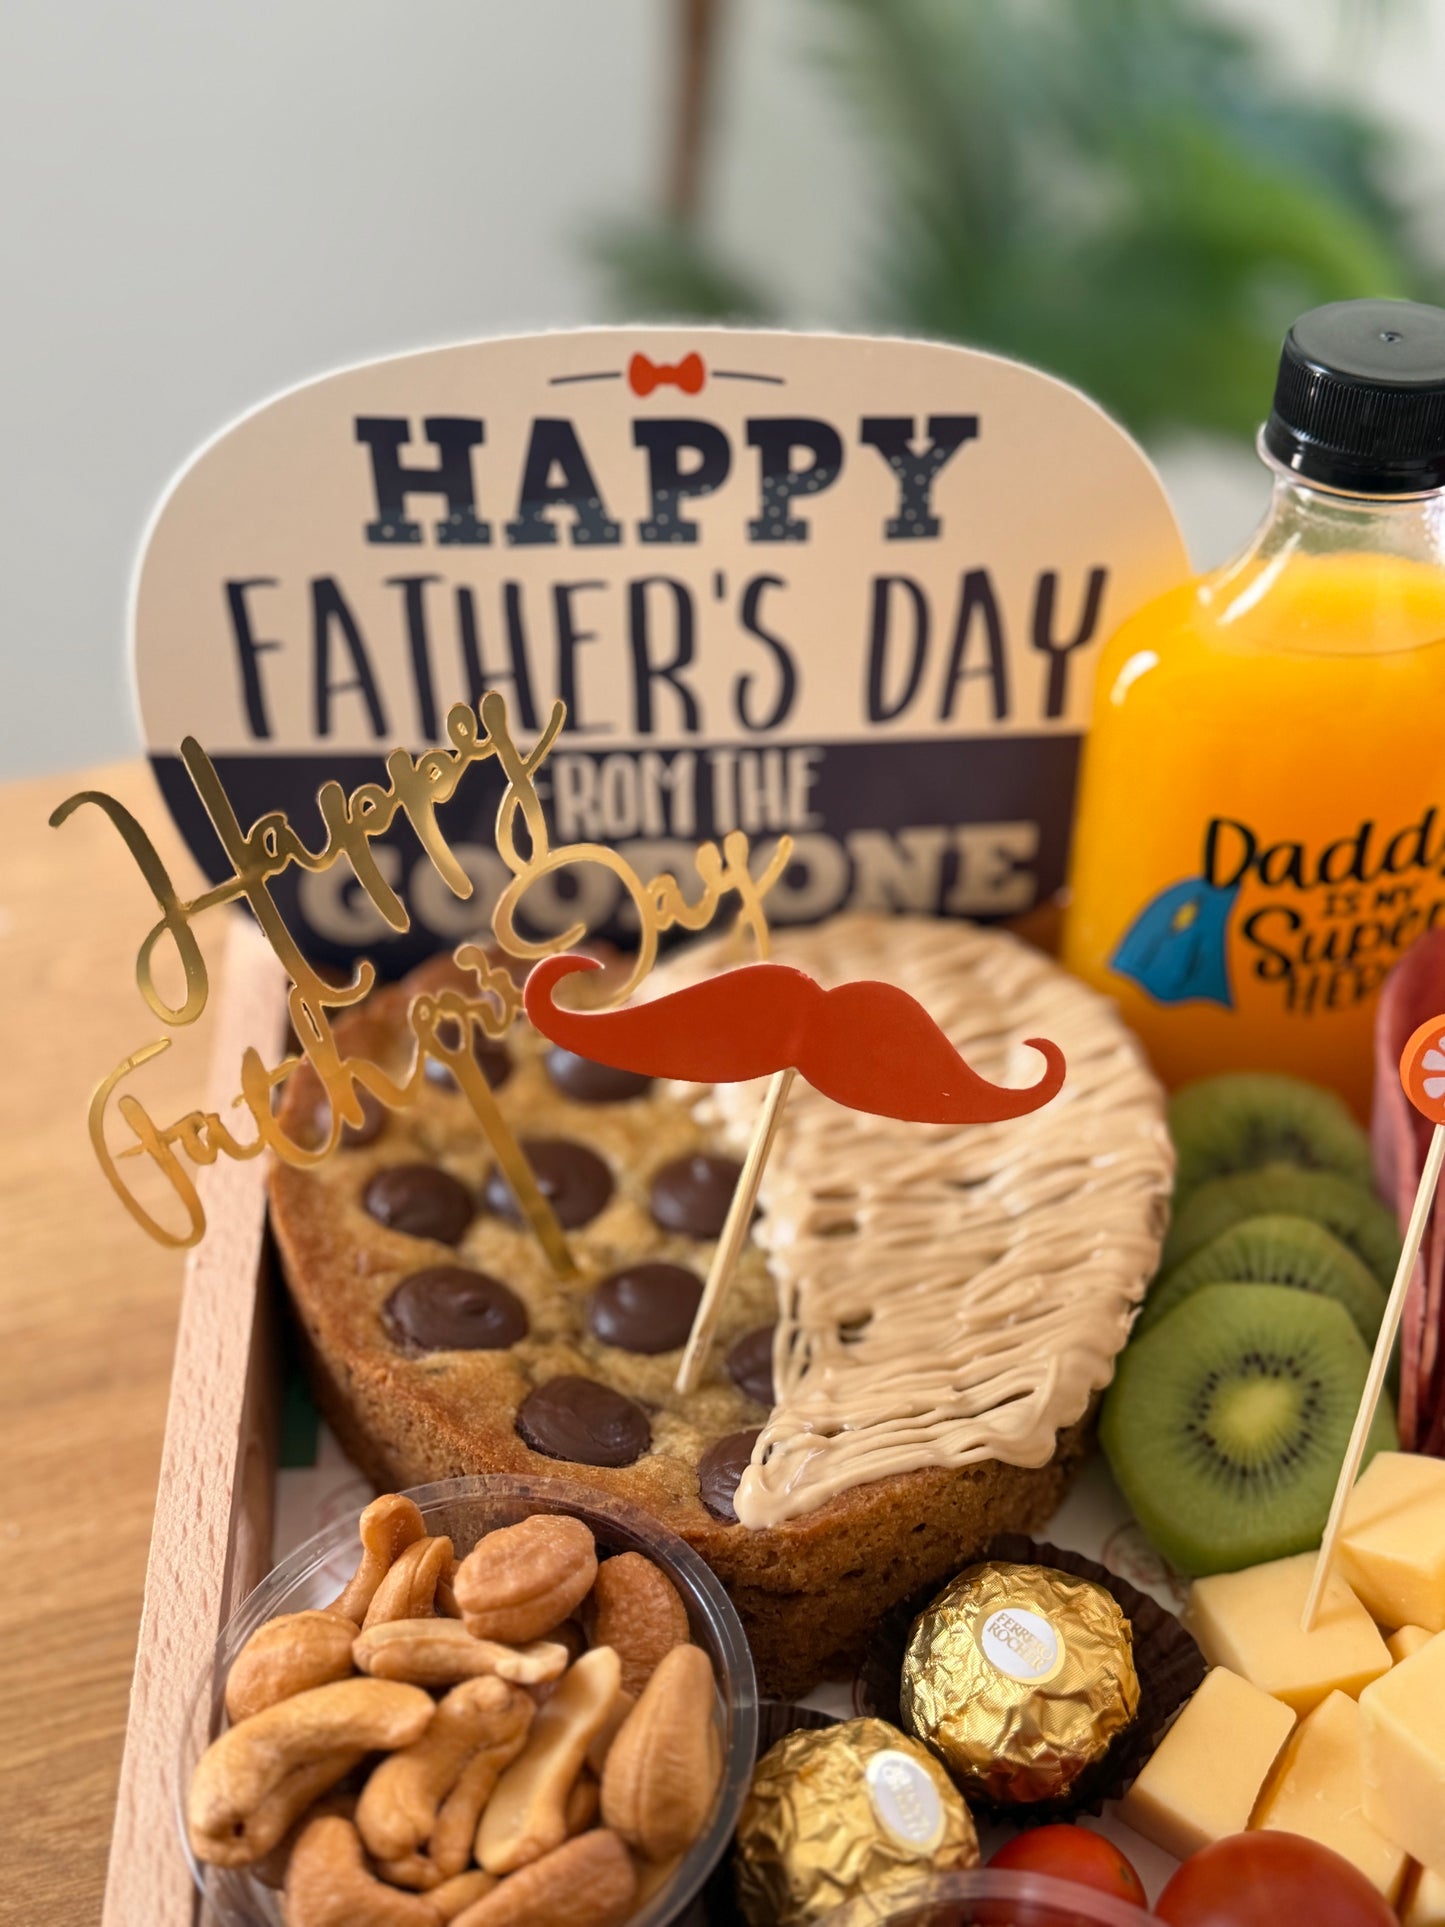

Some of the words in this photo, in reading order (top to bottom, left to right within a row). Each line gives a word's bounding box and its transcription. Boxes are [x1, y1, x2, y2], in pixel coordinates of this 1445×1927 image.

[354, 413, 980, 548] HAPPY
[223, 568, 803, 742] FATHER'S
[862, 564, 1109, 726] DAY
[704, 748, 821, 837] THE
[48, 690, 567, 1026] Happy
[746, 821, 1041, 926] ONE
[1203, 804, 1445, 892] Dadd
[1323, 889, 1359, 918] IS
